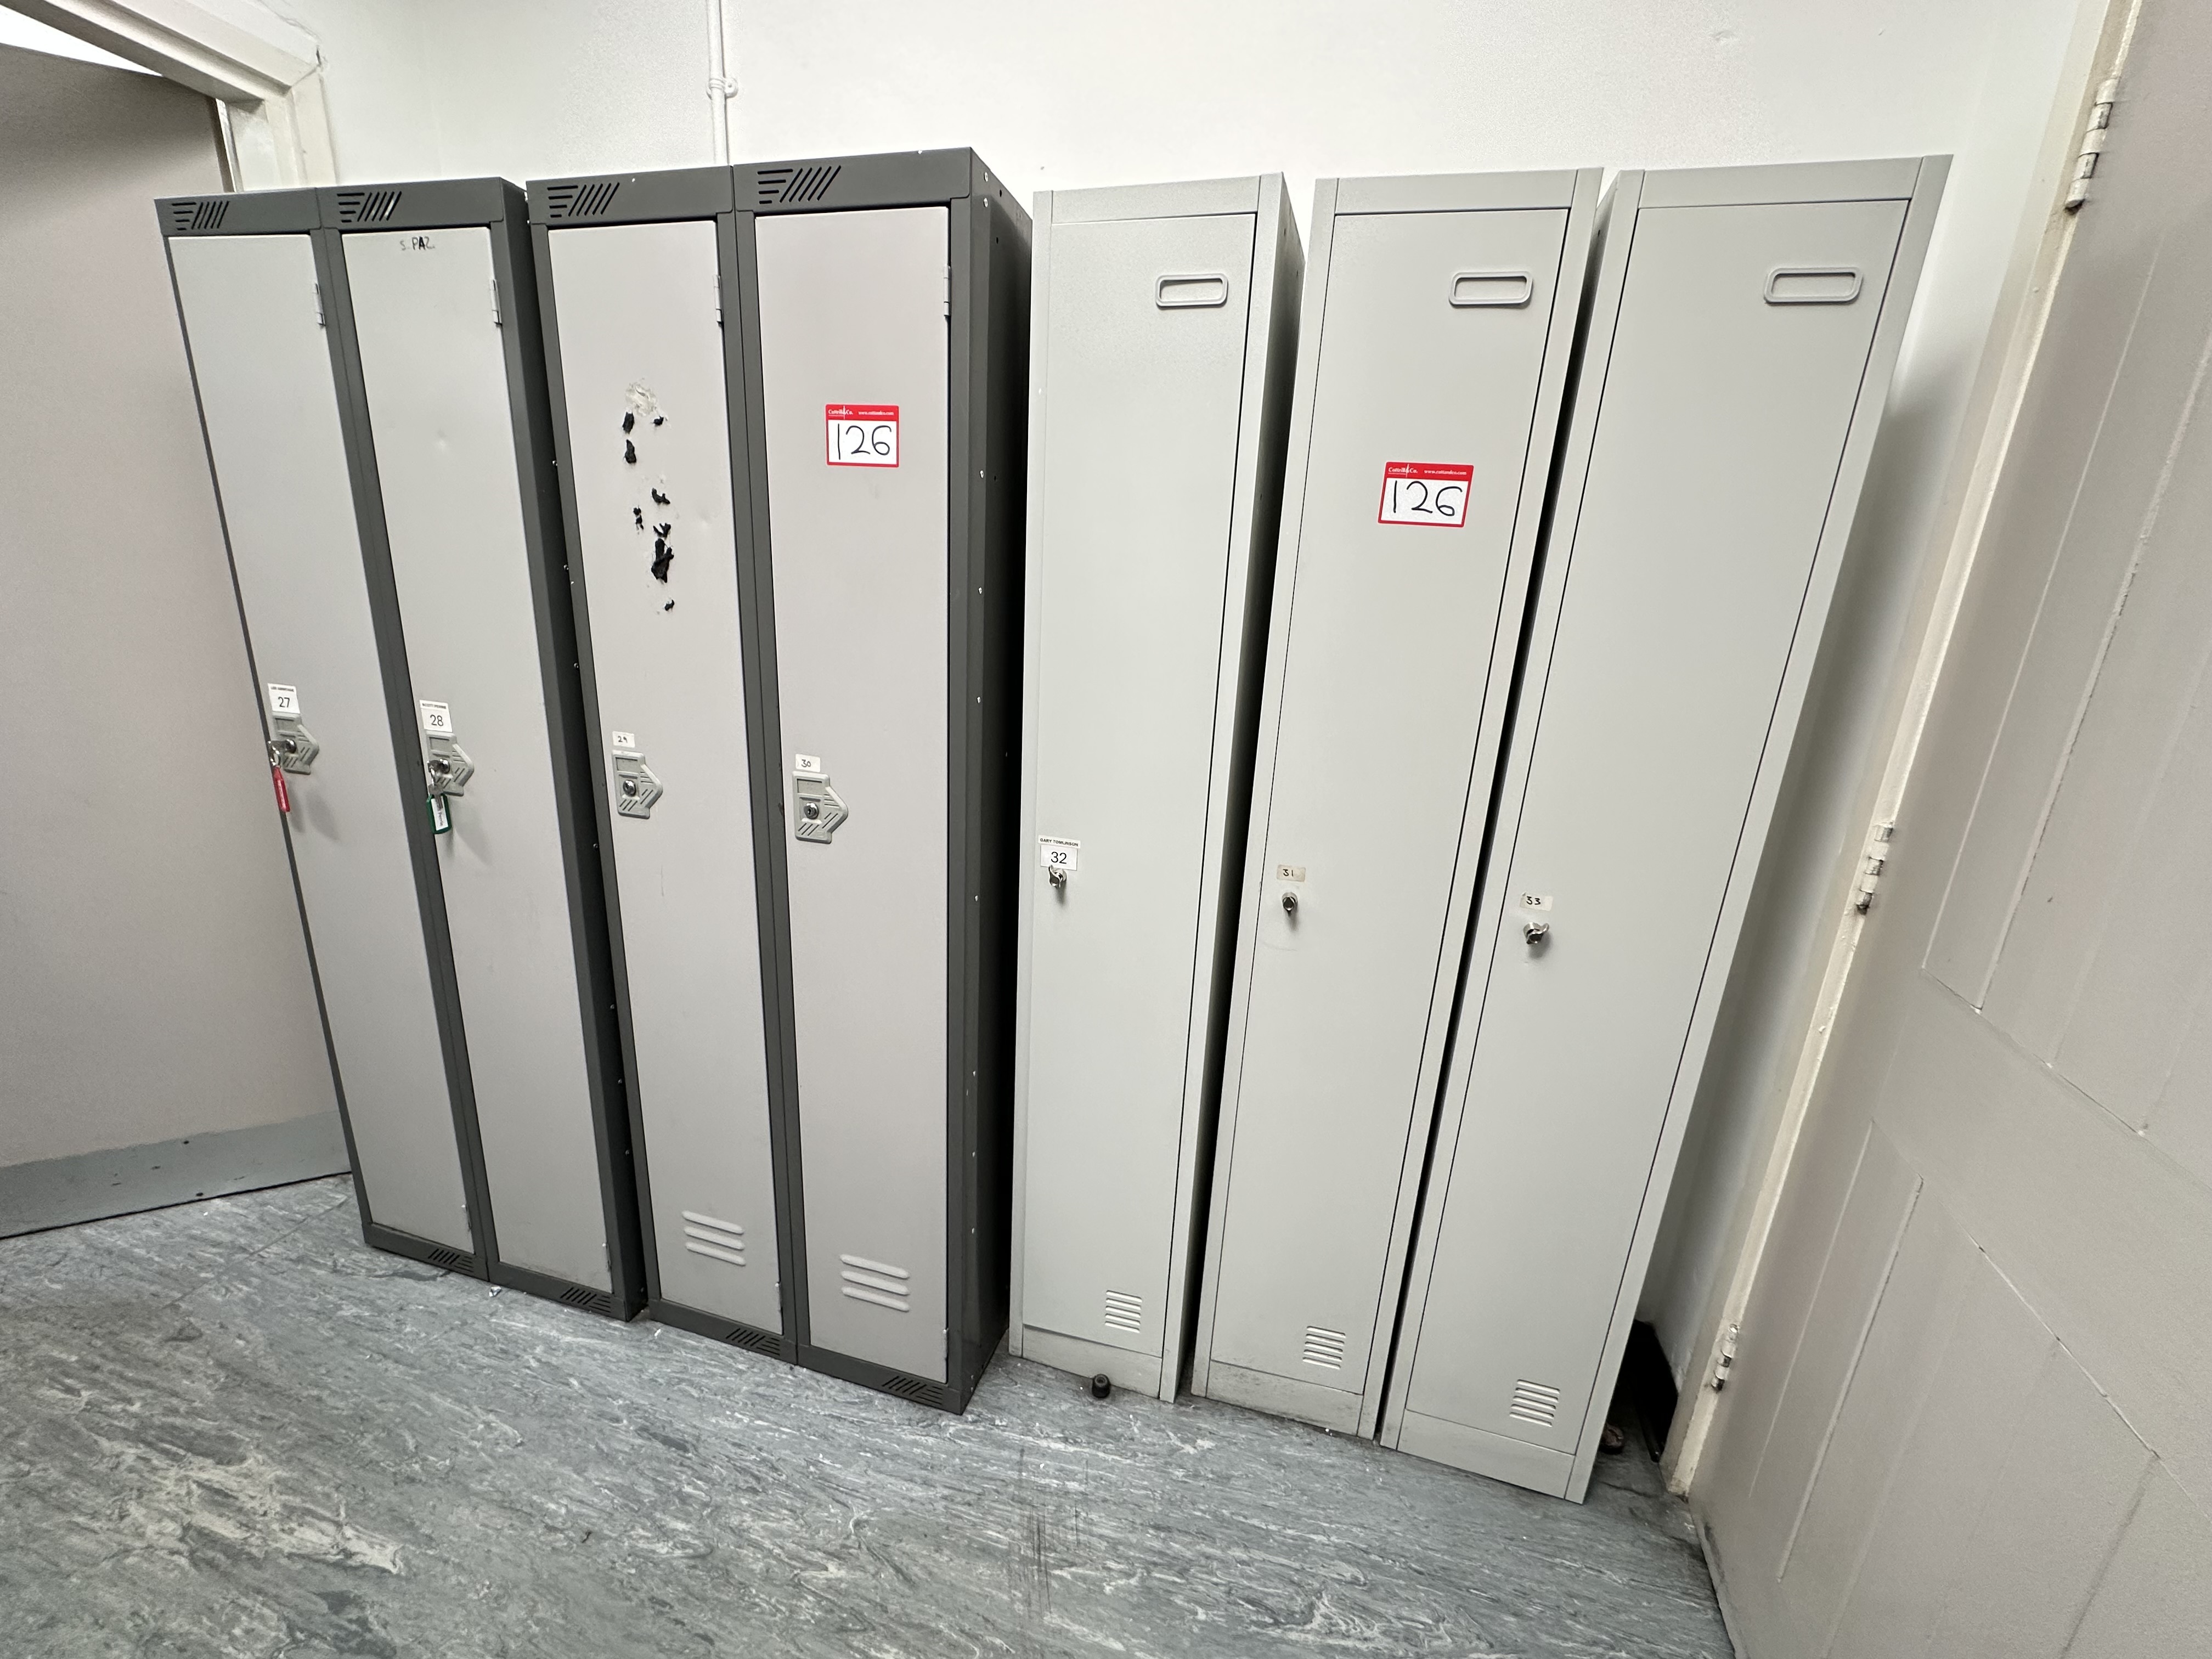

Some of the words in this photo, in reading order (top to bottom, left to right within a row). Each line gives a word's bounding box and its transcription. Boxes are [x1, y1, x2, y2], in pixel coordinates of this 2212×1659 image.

[837, 423, 892, 460] 126
[1393, 480, 1463, 517] 126
[278, 697, 290, 708] 27
[430, 714, 444, 726] 28
[801, 759, 811, 768] 30
[1051, 851, 1067, 865] 32
[1283, 868, 1294, 877] 31
[1526, 896, 1541, 905] 33
